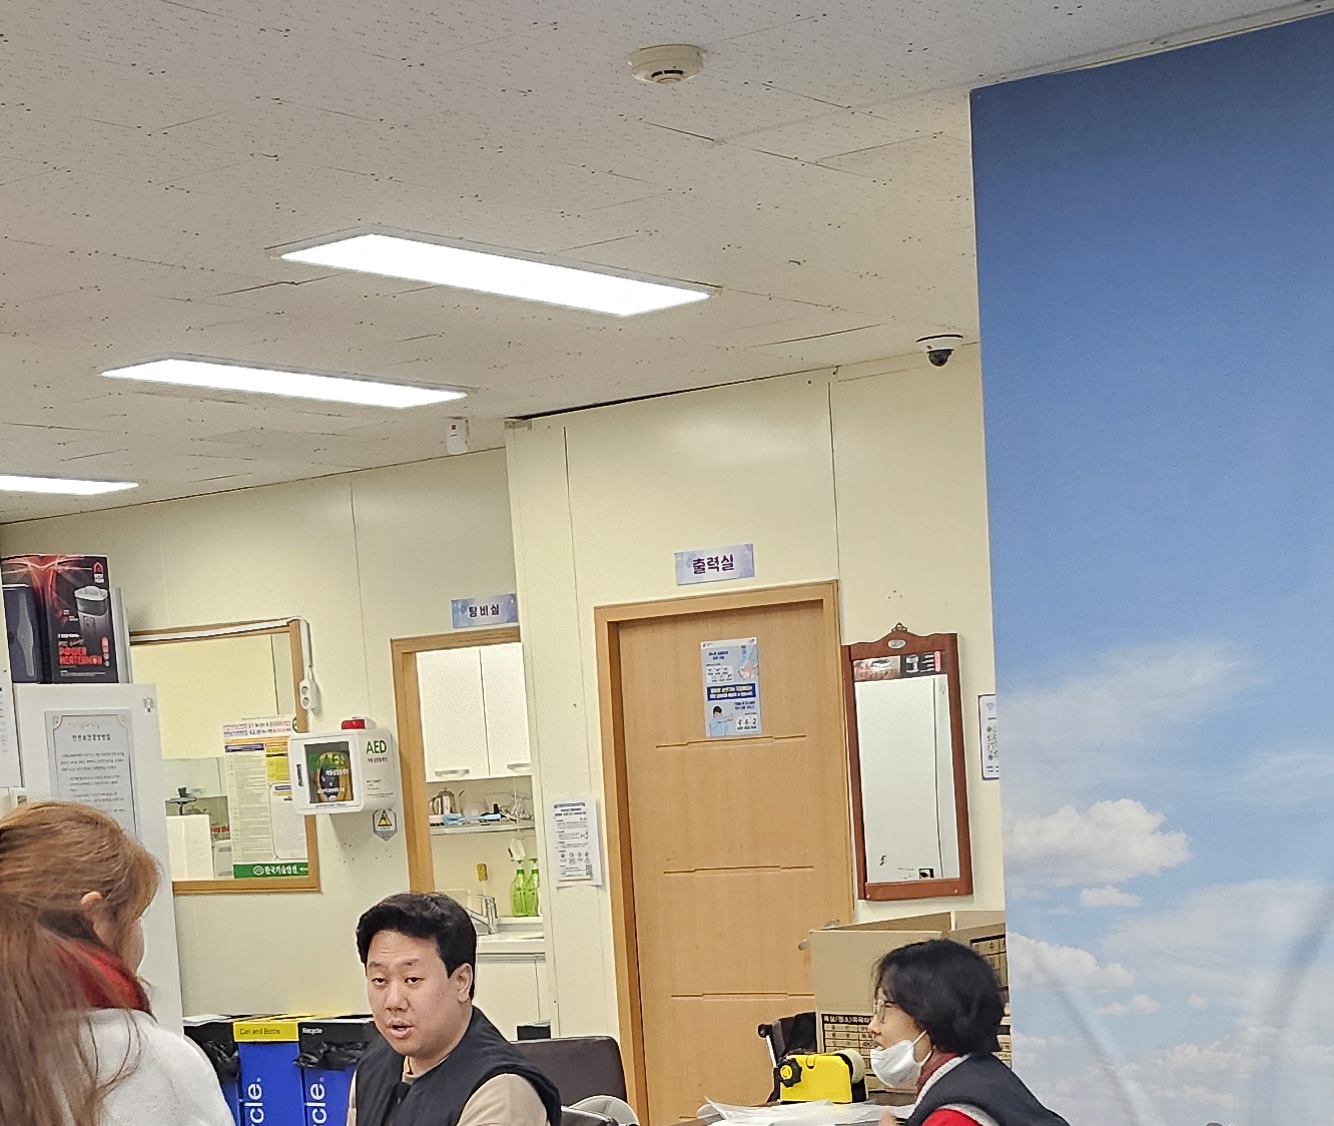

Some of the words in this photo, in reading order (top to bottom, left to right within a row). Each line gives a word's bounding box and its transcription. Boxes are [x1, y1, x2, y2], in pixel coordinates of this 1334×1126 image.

[692, 553, 735, 575] 출력실
[469, 604, 500, 618] 탕비실
[365, 739, 387, 754] AED
